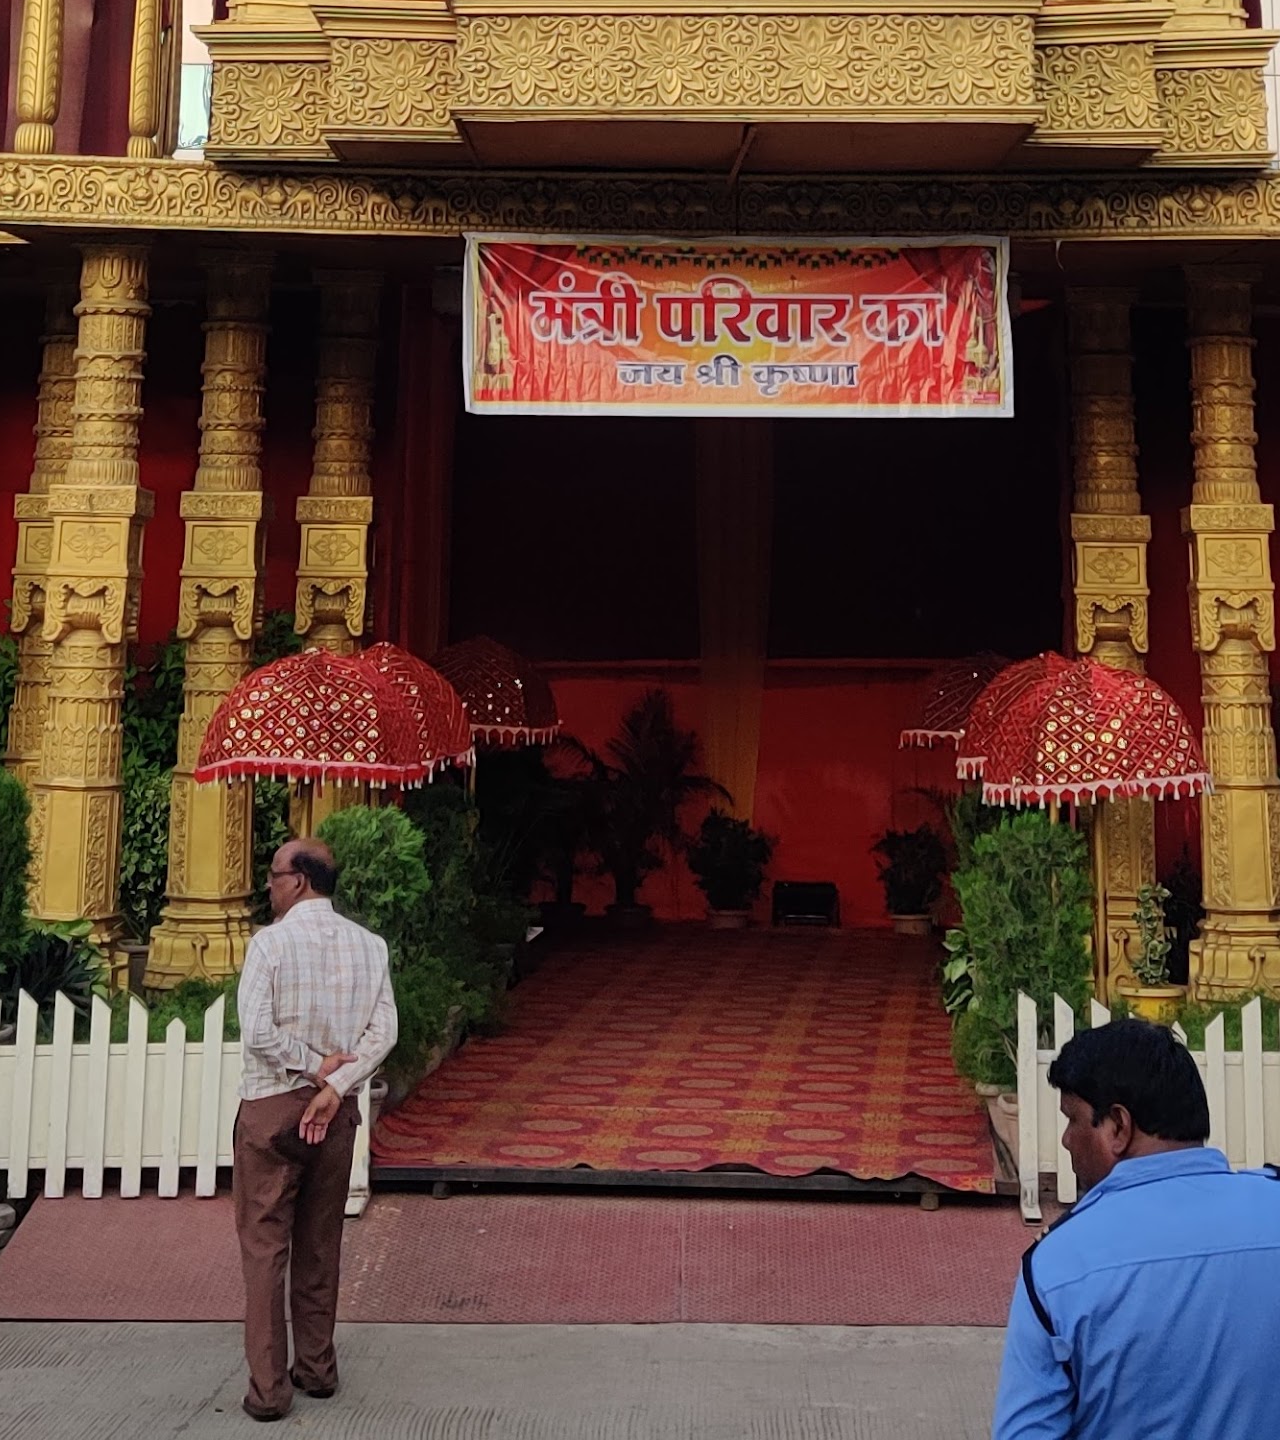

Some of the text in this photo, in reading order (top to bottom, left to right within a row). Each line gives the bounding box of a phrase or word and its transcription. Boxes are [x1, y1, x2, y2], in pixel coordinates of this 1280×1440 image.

[530, 271, 947, 346] मंत्री परिवार का
[618, 353, 860, 398] जय श्री कृष्णा
